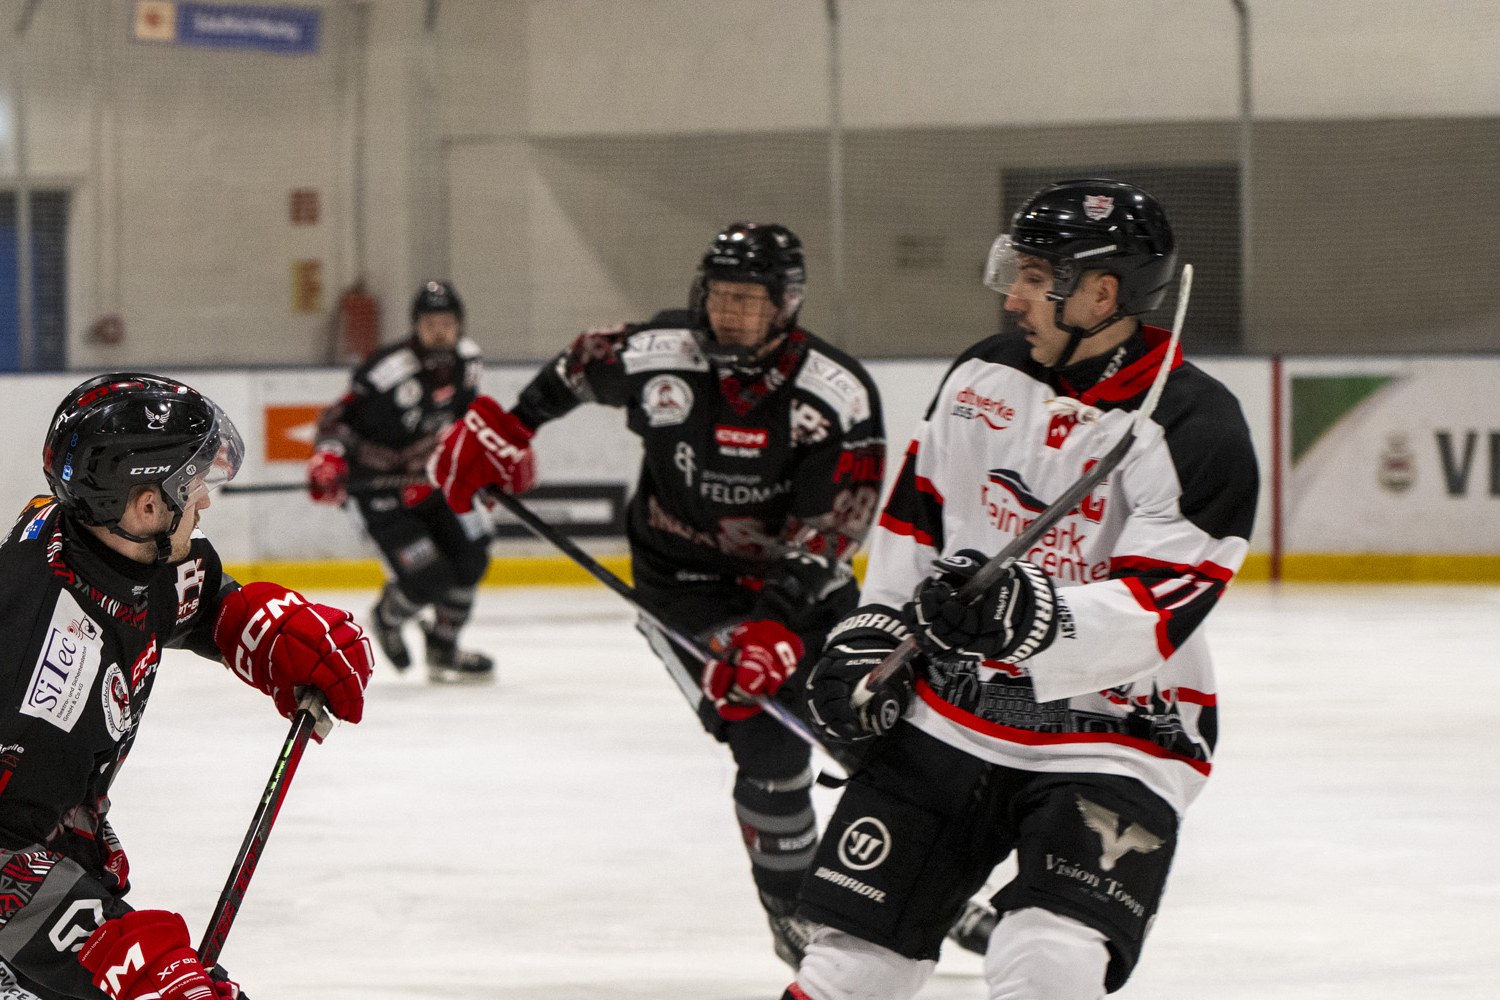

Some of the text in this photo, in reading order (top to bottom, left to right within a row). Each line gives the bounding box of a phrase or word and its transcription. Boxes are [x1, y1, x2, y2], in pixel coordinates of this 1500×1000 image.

[465, 408, 526, 464] CCM
[129, 464, 172, 476] CCM
[1026, 547, 1109, 585] cente
[235, 591, 305, 684] CCM
[27, 626, 78, 713] SiTec
[62, 704, 76, 722] GmbH
[813, 866, 887, 904] WARRIOR
[1044, 852, 1102, 890] Vision
[1104, 875, 1147, 918] Town
[156, 959, 181, 982] XF
